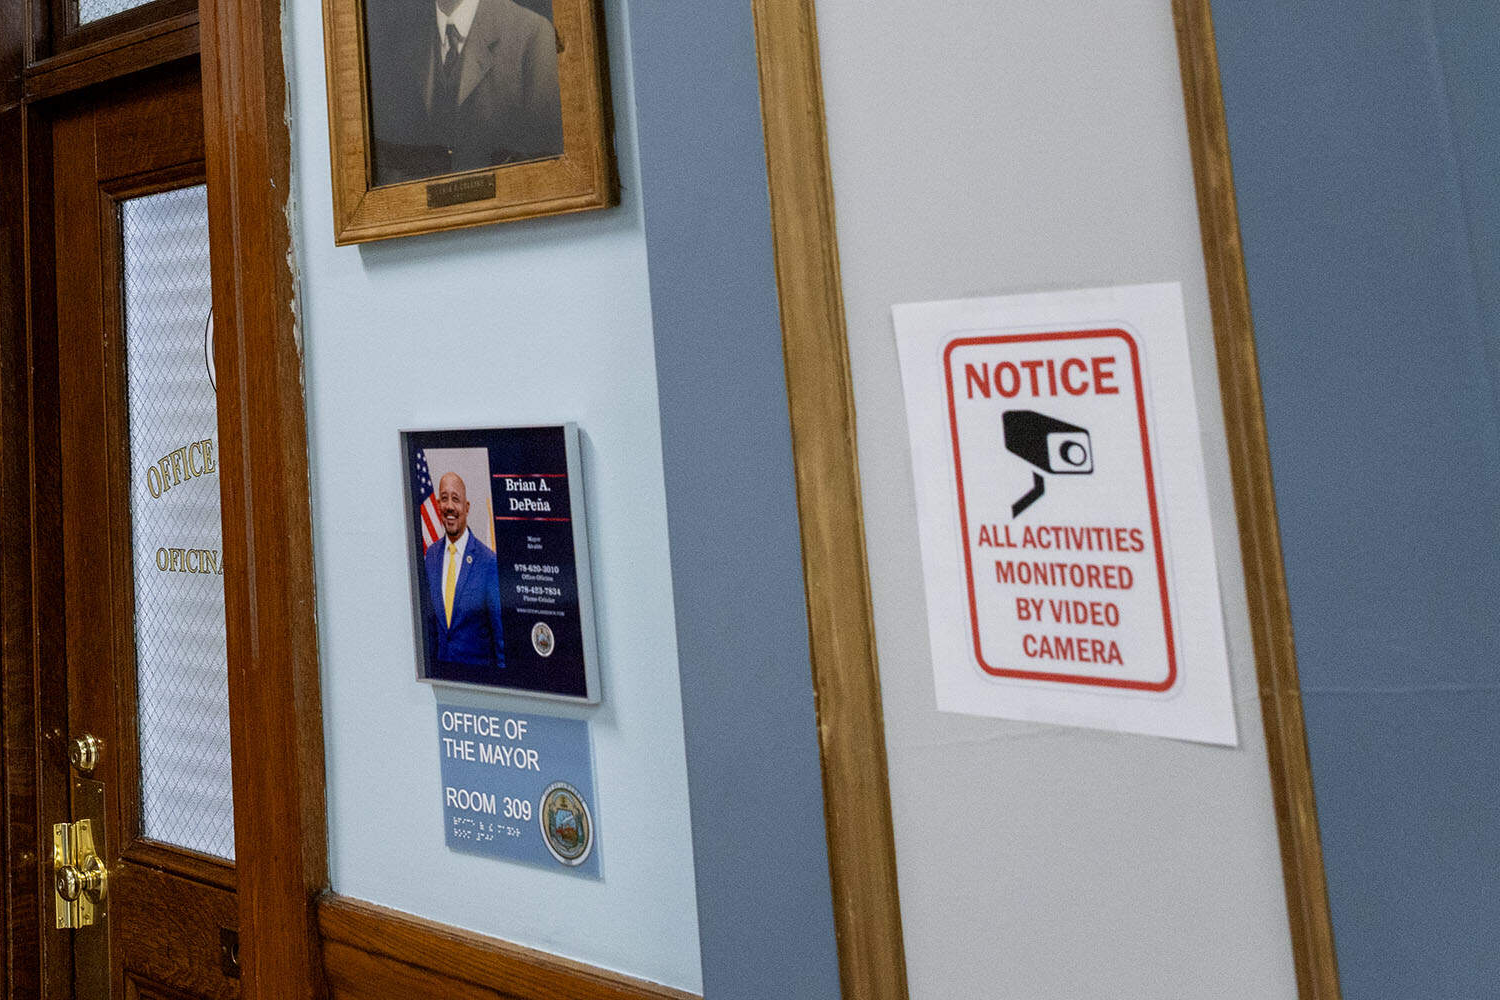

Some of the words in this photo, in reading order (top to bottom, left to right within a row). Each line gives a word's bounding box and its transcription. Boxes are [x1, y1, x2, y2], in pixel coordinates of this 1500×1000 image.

[965, 356, 1120, 399] NOTICE
[147, 439, 216, 499] OFFICE
[505, 478, 537, 492] Brian
[539, 478, 551, 492] A.
[509, 498, 551, 512] DePeña
[978, 524, 1017, 549] ALL
[1022, 526, 1145, 553] ACTIVITIES
[995, 561, 1133, 590] MONITORED
[1016, 598, 1048, 622] BY
[1050, 600, 1120, 627] VIDEO
[1022, 634, 1124, 666] CAMERA
[442, 711, 501, 738] OFFICE
[504, 719, 528, 741] OF
[443, 737, 476, 762] THE
[479, 743, 541, 772] MAYOR
[446, 787, 497, 815] ROOM
[503, 797, 532, 821] 309
